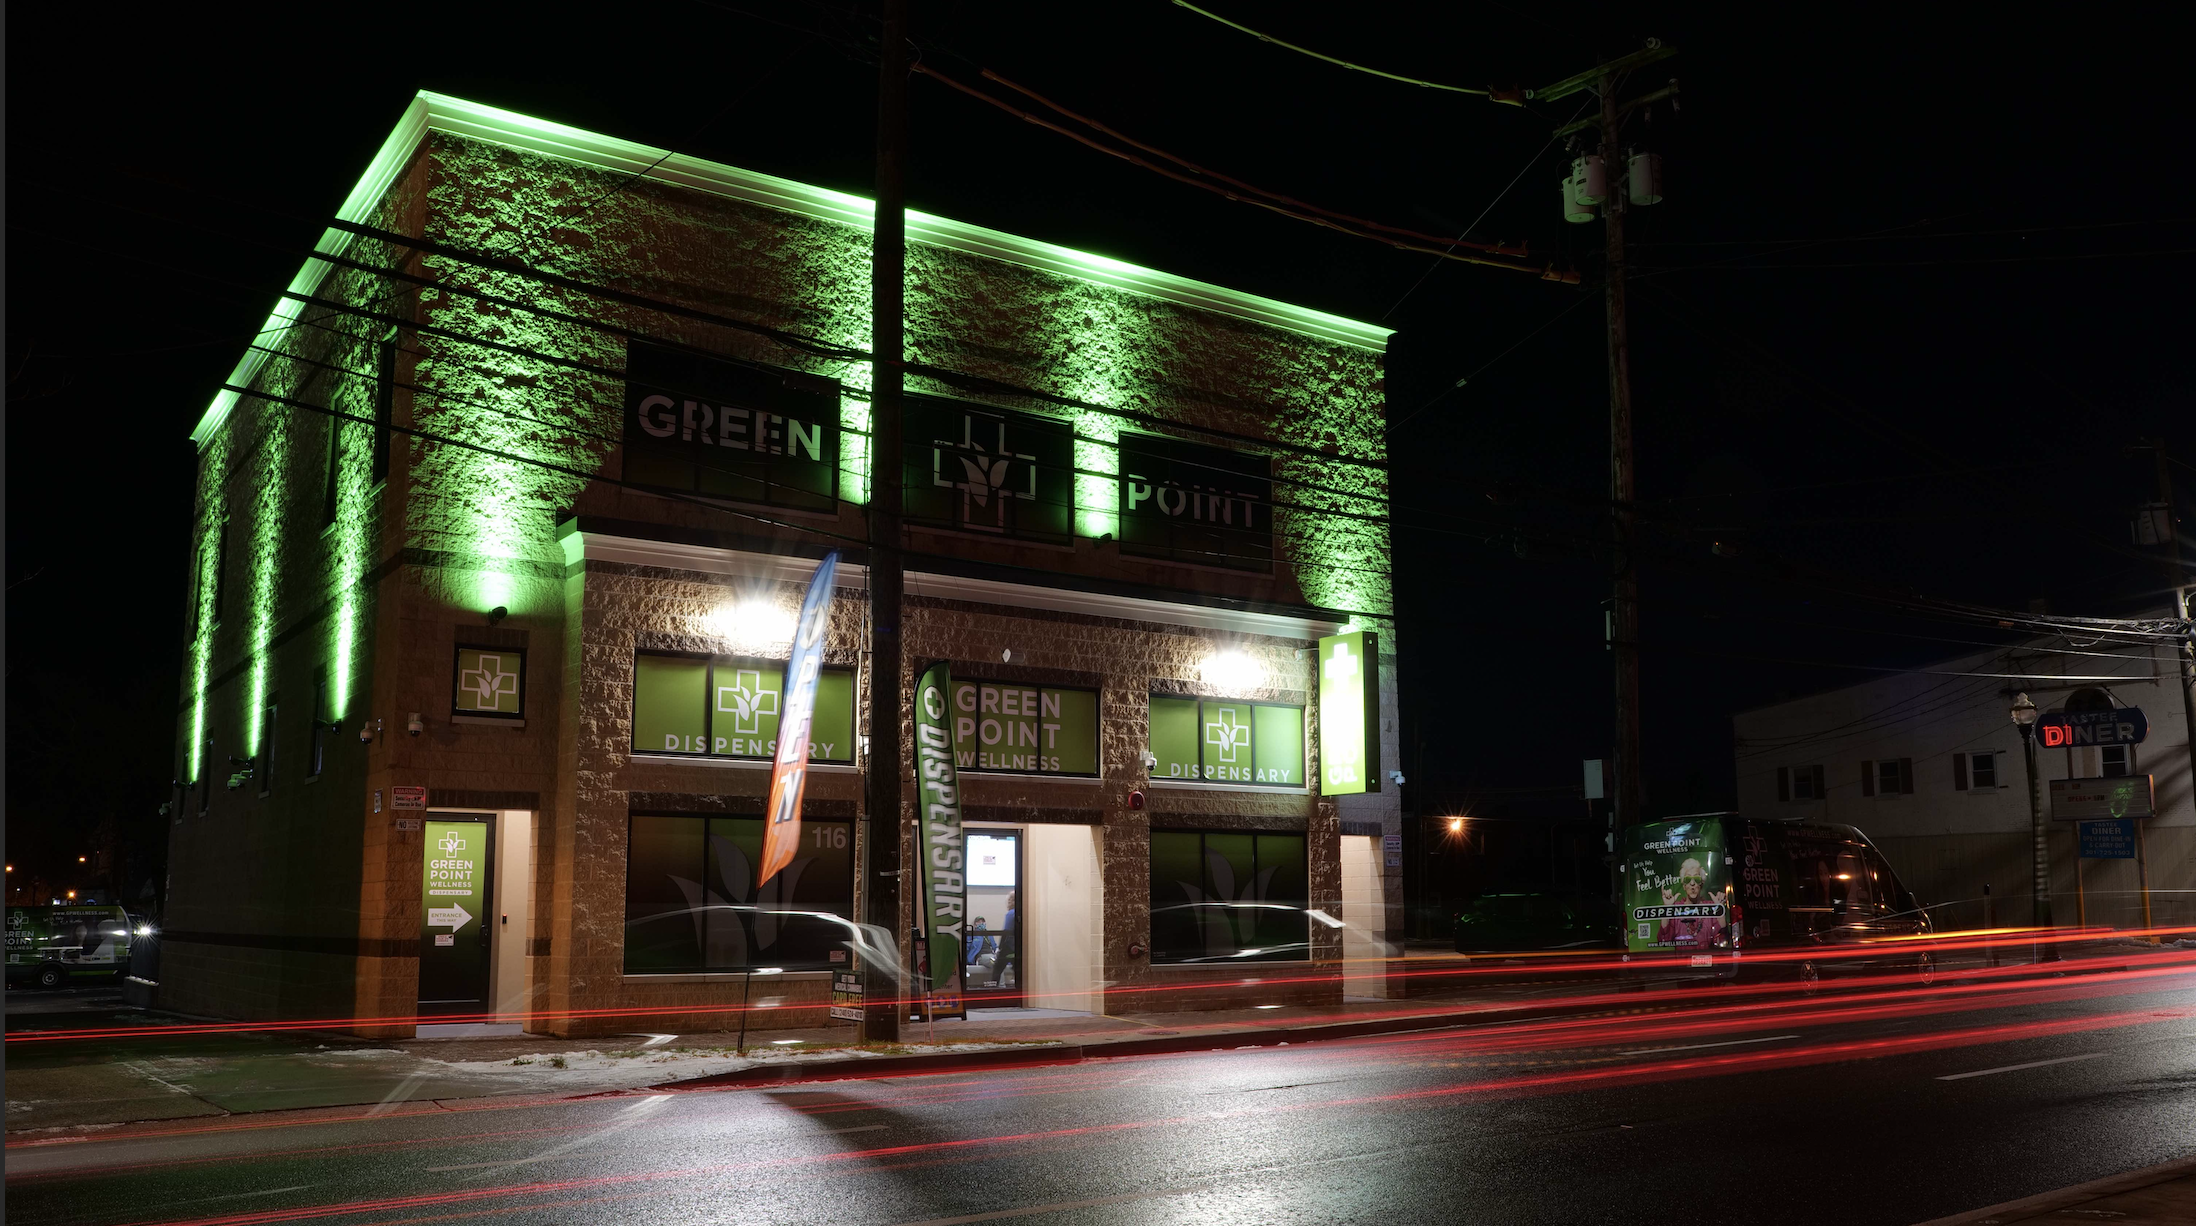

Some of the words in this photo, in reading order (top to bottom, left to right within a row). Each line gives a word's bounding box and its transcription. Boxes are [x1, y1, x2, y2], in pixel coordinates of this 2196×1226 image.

[638, 395, 821, 461] GREEN
[1128, 474, 1260, 527] POINT
[956, 686, 1060, 718] GREEN
[2060, 712, 2118, 724] TASTEE
[957, 717, 1061, 749] POINT
[2042, 722, 2136, 746] DINER
[665, 734, 834, 758] DISPENSRY
[957, 751, 1060, 772] WELLNESS
[1170, 763, 1290, 783] DISPENSARY
[399, 821, 407, 829] NO
[918, 722, 964, 942] DISPENSARY
[2091, 827, 2122, 835] DINER
[812, 826, 847, 850] 116
[1643, 839, 1672, 850] GREEN
[1672, 838, 1701, 848] POINT
[1656, 846, 1689, 855] WELLNESS
[430, 859, 473, 870] GREEN
[1642, 867, 1656, 877] You
[430, 870, 473, 880] POINT
[1636, 878, 1653, 892] Feel
[1654, 873, 1681, 889] Better
[1744, 867, 1779, 882] GREEN
[1745, 884, 1780, 898] POINT
[1636, 905, 1719, 919] DISPENSARY
[1747, 900, 1783, 910] WELLNESS
[832, 991, 848, 1006] CARD
[848, 993, 863, 1009] FREE
